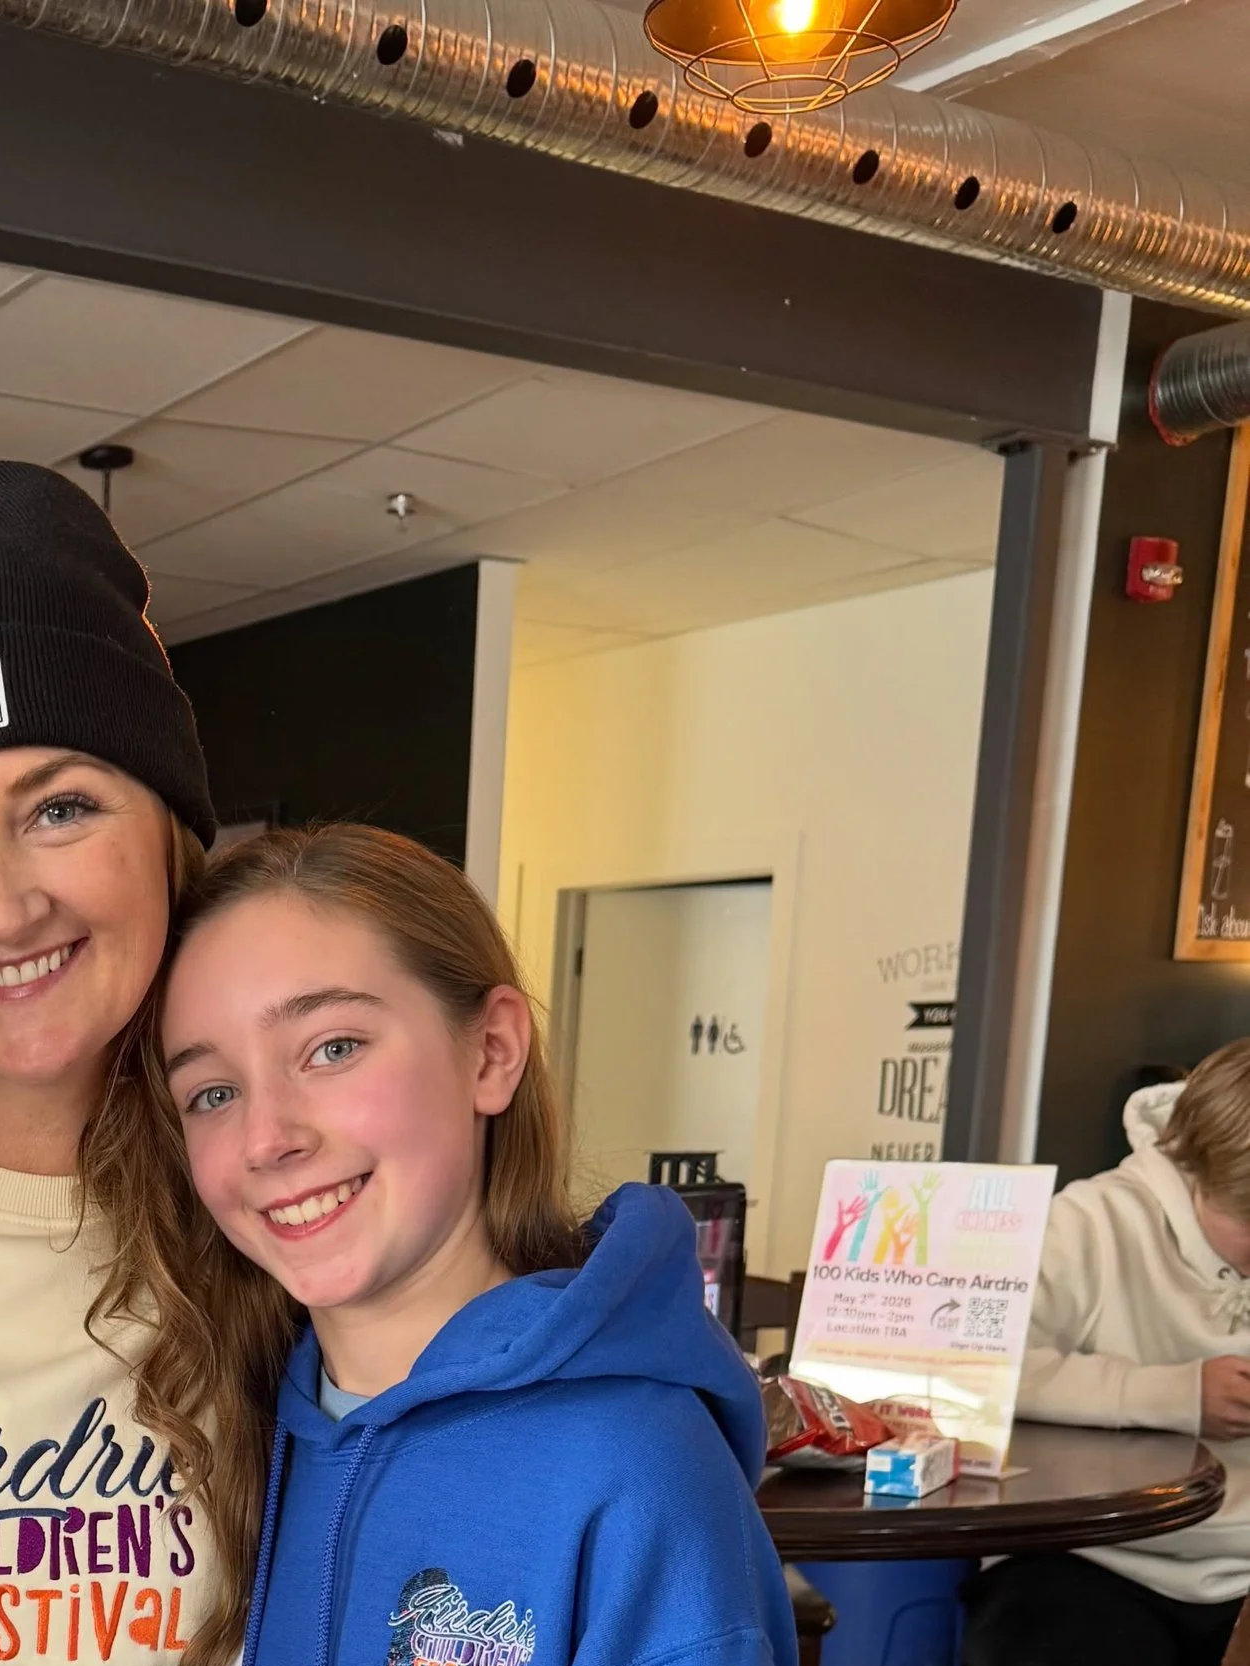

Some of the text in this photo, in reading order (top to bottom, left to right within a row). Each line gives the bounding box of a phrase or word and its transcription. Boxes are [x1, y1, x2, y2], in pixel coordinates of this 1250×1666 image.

[813, 1265, 1029, 1293] 100 Kids Who Care Airdrie
[833, 1292, 856, 1305] May
[827, 1322, 880, 1336] Location
[388, 1584, 537, 1648] Airdrie
